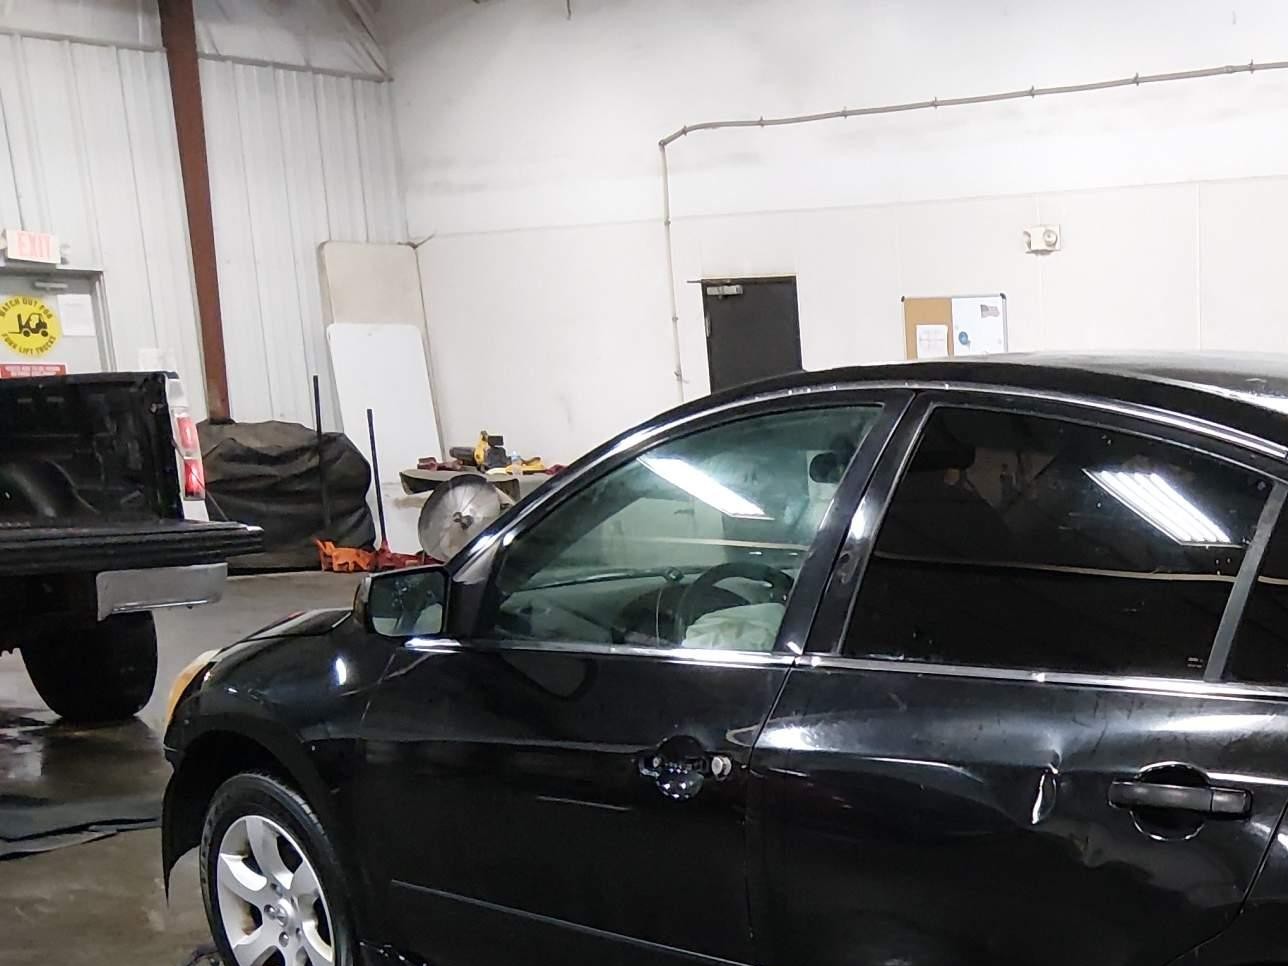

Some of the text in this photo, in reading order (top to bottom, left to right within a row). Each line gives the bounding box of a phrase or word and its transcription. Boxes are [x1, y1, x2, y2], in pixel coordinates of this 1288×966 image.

[18, 231, 50, 259] EXIT
[0, 299, 20, 317] WATCH
[22, 297, 37, 307] OUT
[39, 305, 53, 319] FOR
[19, 347, 33, 356] LIFT
[35, 336, 56, 352] TRUCKS
